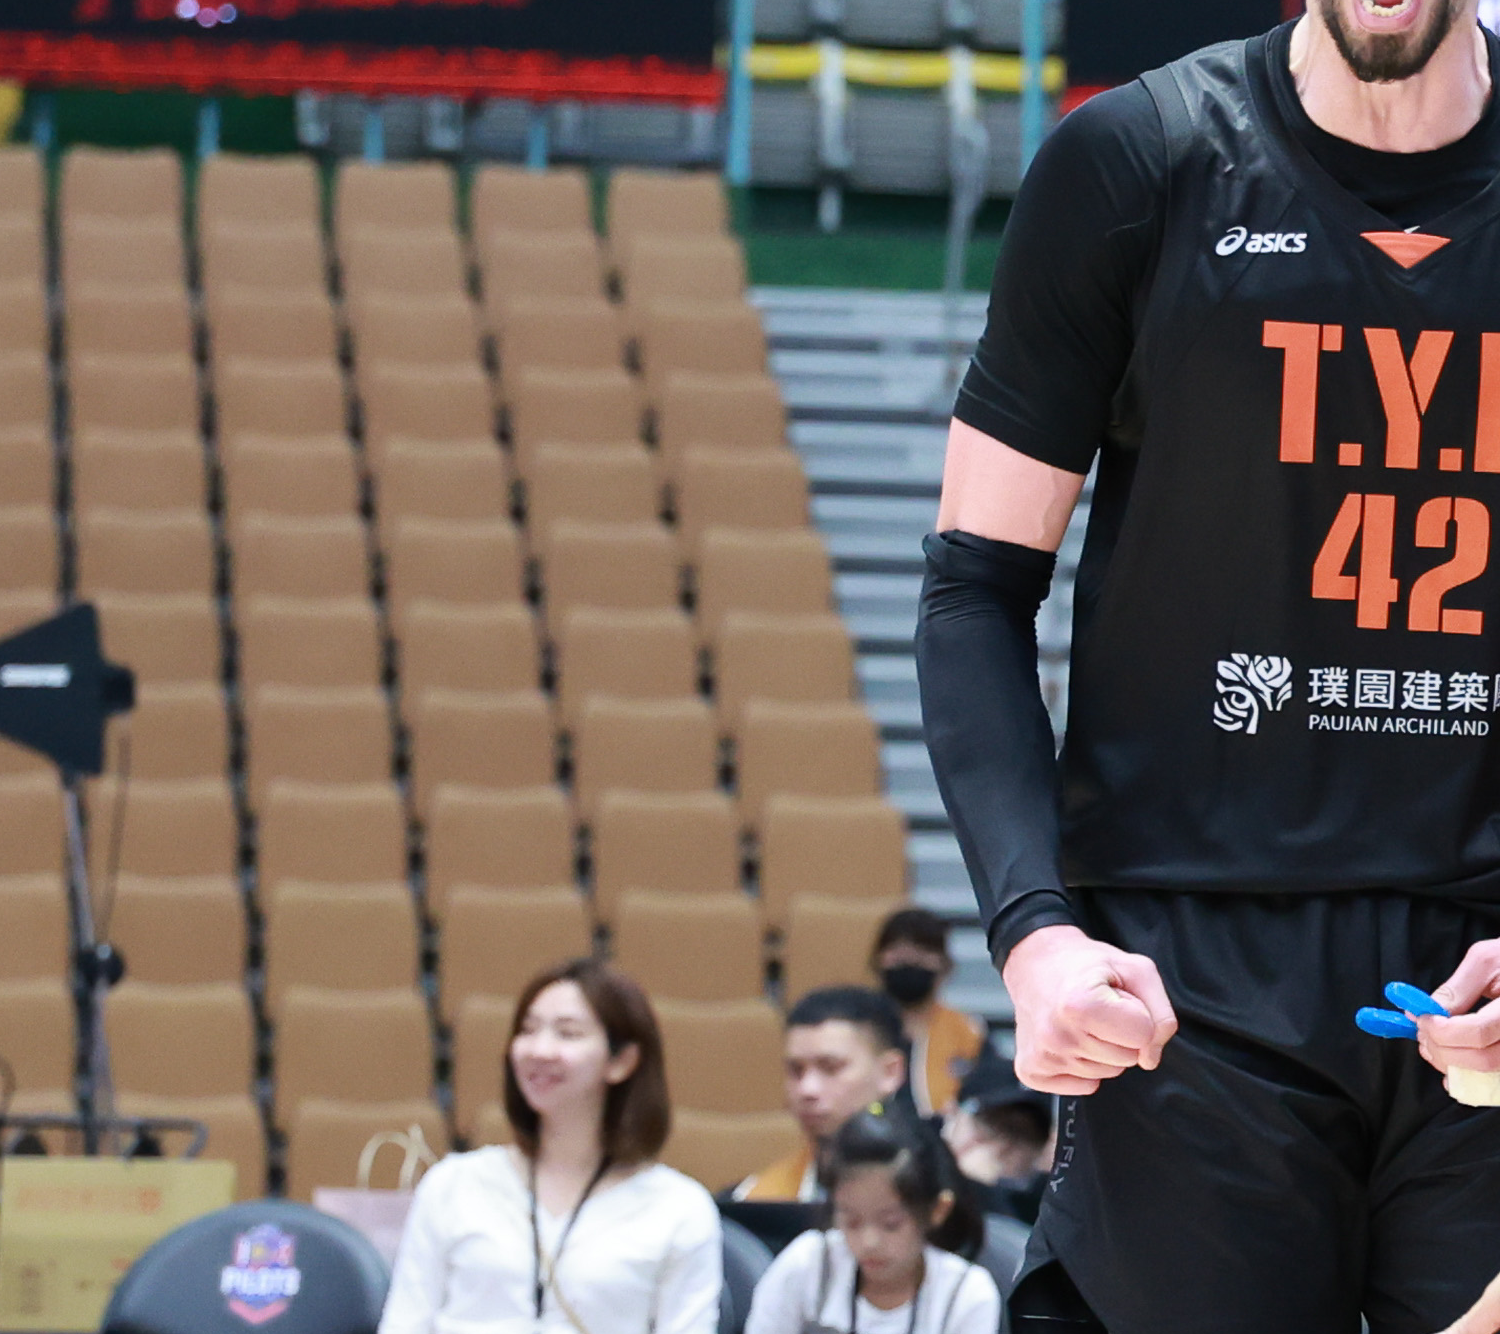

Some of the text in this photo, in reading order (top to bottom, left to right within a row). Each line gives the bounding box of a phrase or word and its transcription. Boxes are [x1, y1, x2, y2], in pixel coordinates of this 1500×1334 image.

[1311, 493, 1491, 635] 42
[1308, 714, 1490, 737] PAUIAN ARCHILAND
